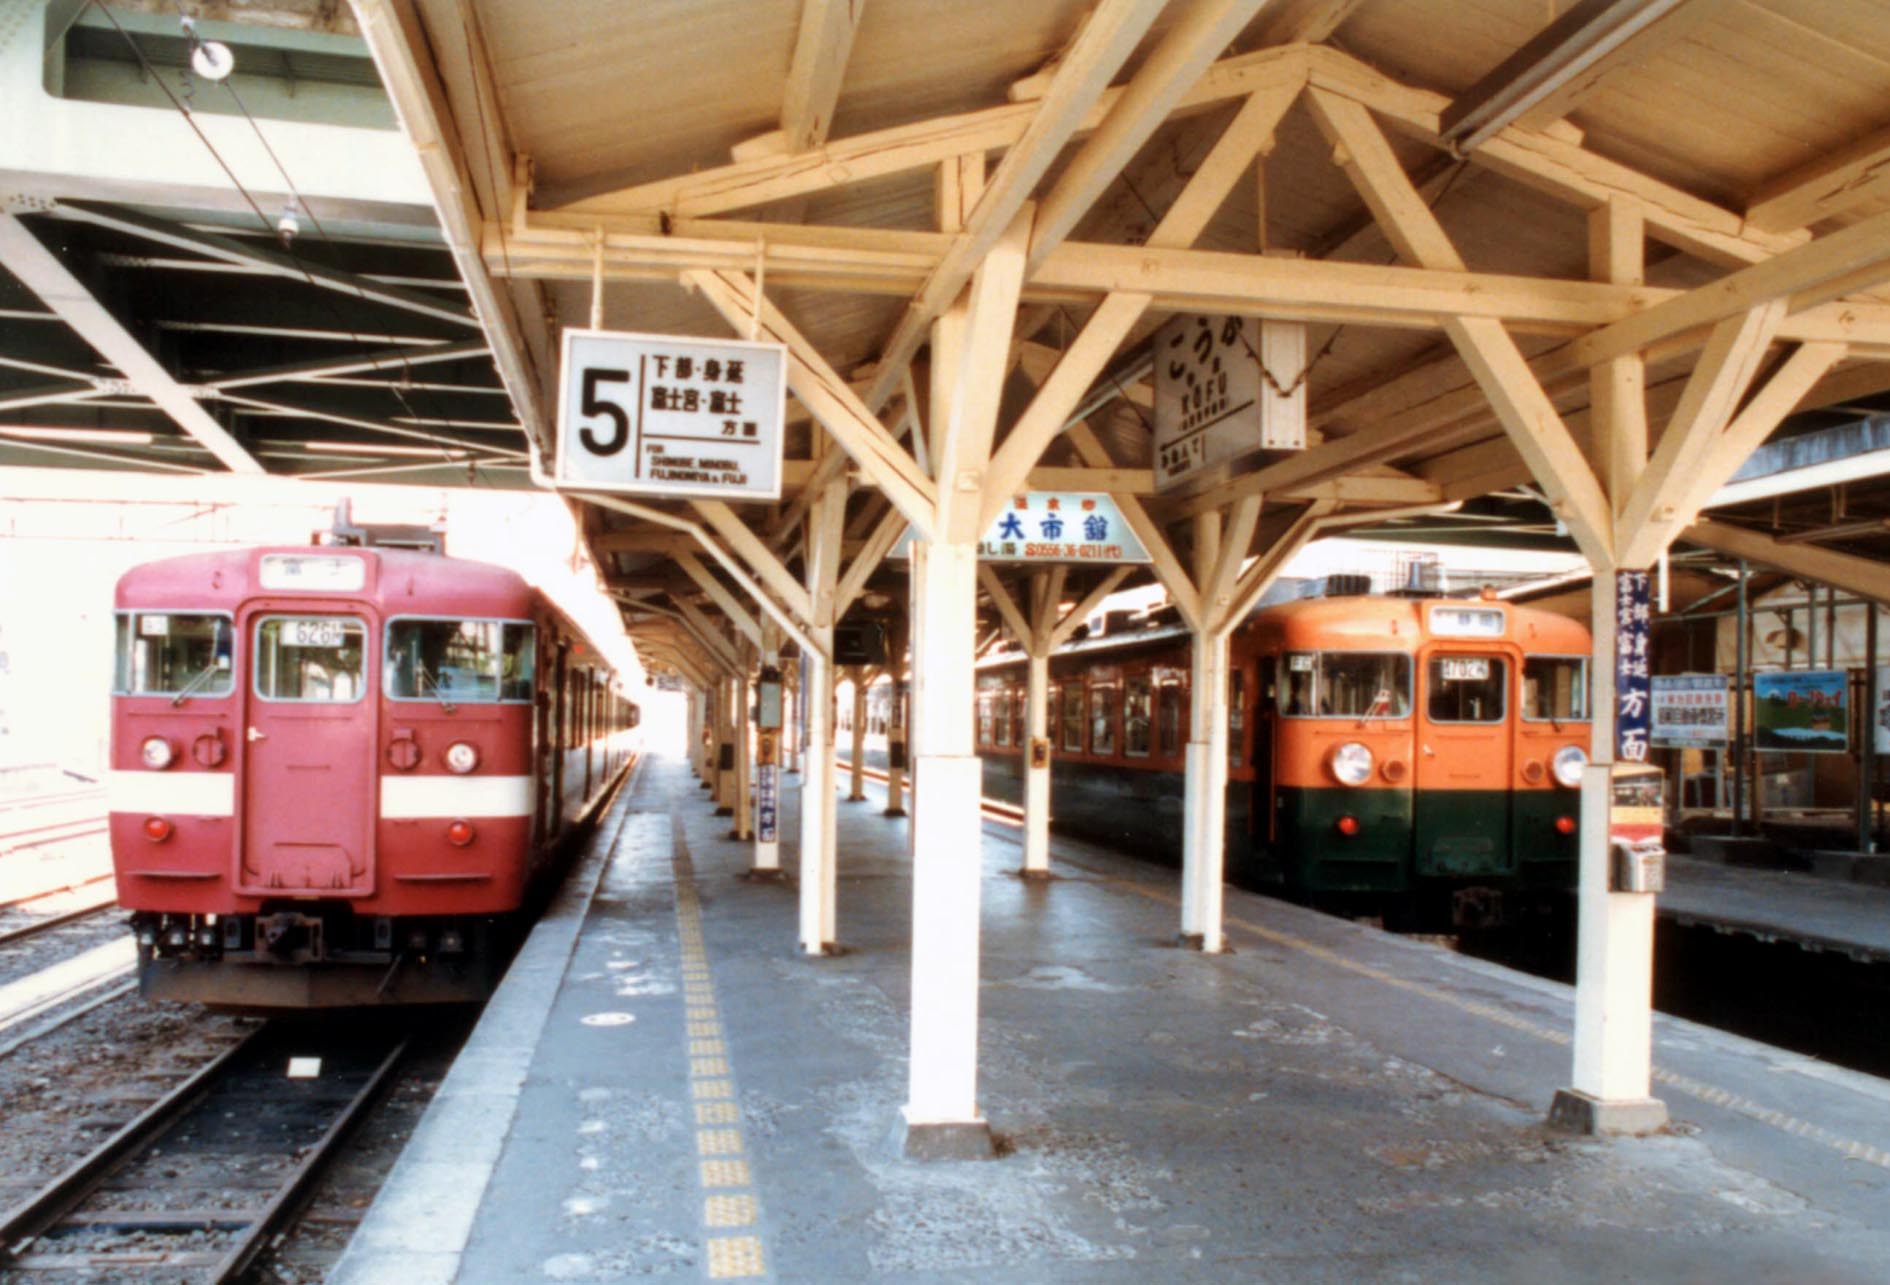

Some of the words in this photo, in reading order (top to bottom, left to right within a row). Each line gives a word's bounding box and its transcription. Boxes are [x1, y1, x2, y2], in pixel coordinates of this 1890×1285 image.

[653, 354, 745, 384] 下部・身延
[651, 386, 743, 415] 富士宮・富士
[1181, 372, 1227, 415] KOFU
[579, 367, 631, 457] 5
[722, 420, 757, 436] 方面
[646, 444, 664, 453] FOR
[650, 468, 709, 482] FUJINOMIYA
[722, 473, 747, 484] FUJI
[1621, 688, 1647, 761] 方面
